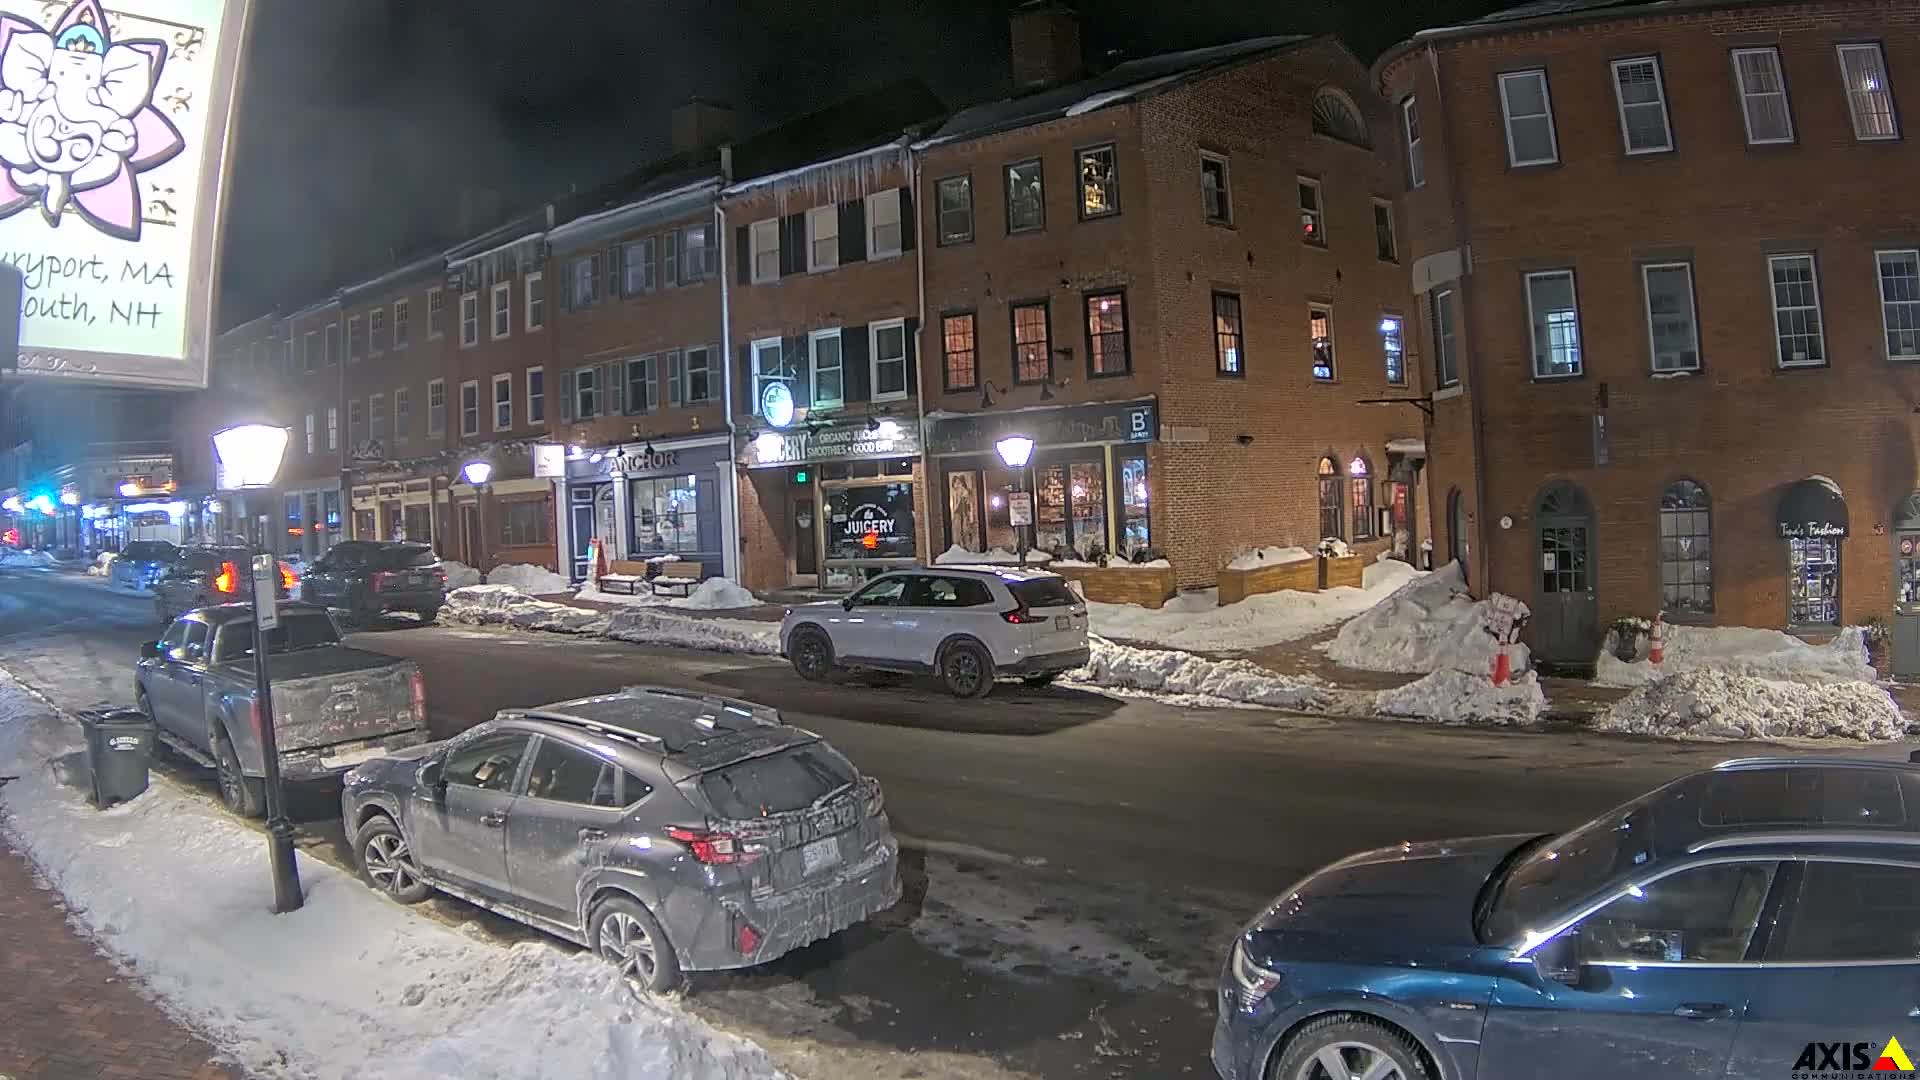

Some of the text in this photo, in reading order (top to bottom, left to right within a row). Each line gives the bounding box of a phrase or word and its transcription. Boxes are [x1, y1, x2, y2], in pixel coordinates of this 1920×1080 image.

[0, 251, 174, 290] ryport, MA
[110, 300, 163, 328] NH
[819, 431, 851, 444] ORGANIC
[807, 445, 846, 457] SMOOTHIES
[852, 442, 875, 454] GOOD
[610, 451, 677, 472] ANCHOR
[844, 519, 895, 534] JUICERY
